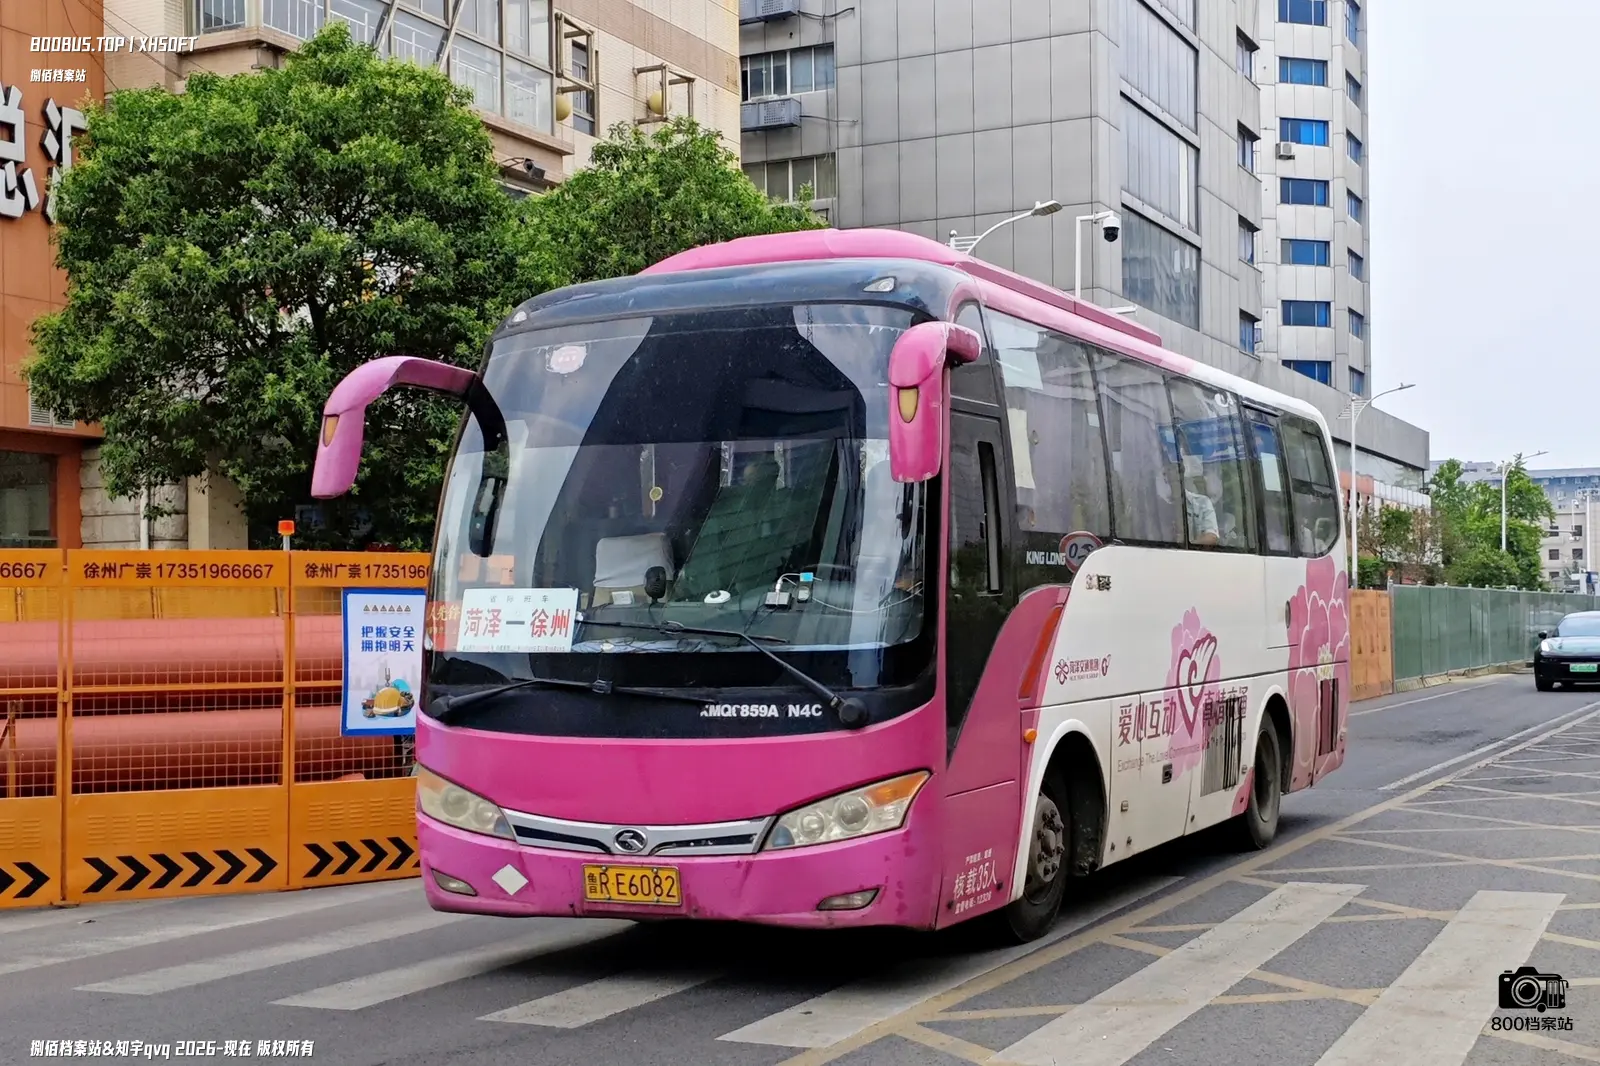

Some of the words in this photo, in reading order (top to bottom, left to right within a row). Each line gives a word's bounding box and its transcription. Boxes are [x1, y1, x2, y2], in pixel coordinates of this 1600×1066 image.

[1026, 551, 1045, 565] KING
[1046, 552, 1066, 566] LONG
[83, 562, 151, 579] 徐州广崇
[156, 563, 274, 579] 17351966667
[305, 563, 361, 579] 徐州广崇
[361, 640, 415, 652] 拥抱明天
[788, 704, 822, 717] N4C
[1118, 697, 1177, 747] 爱心互动
